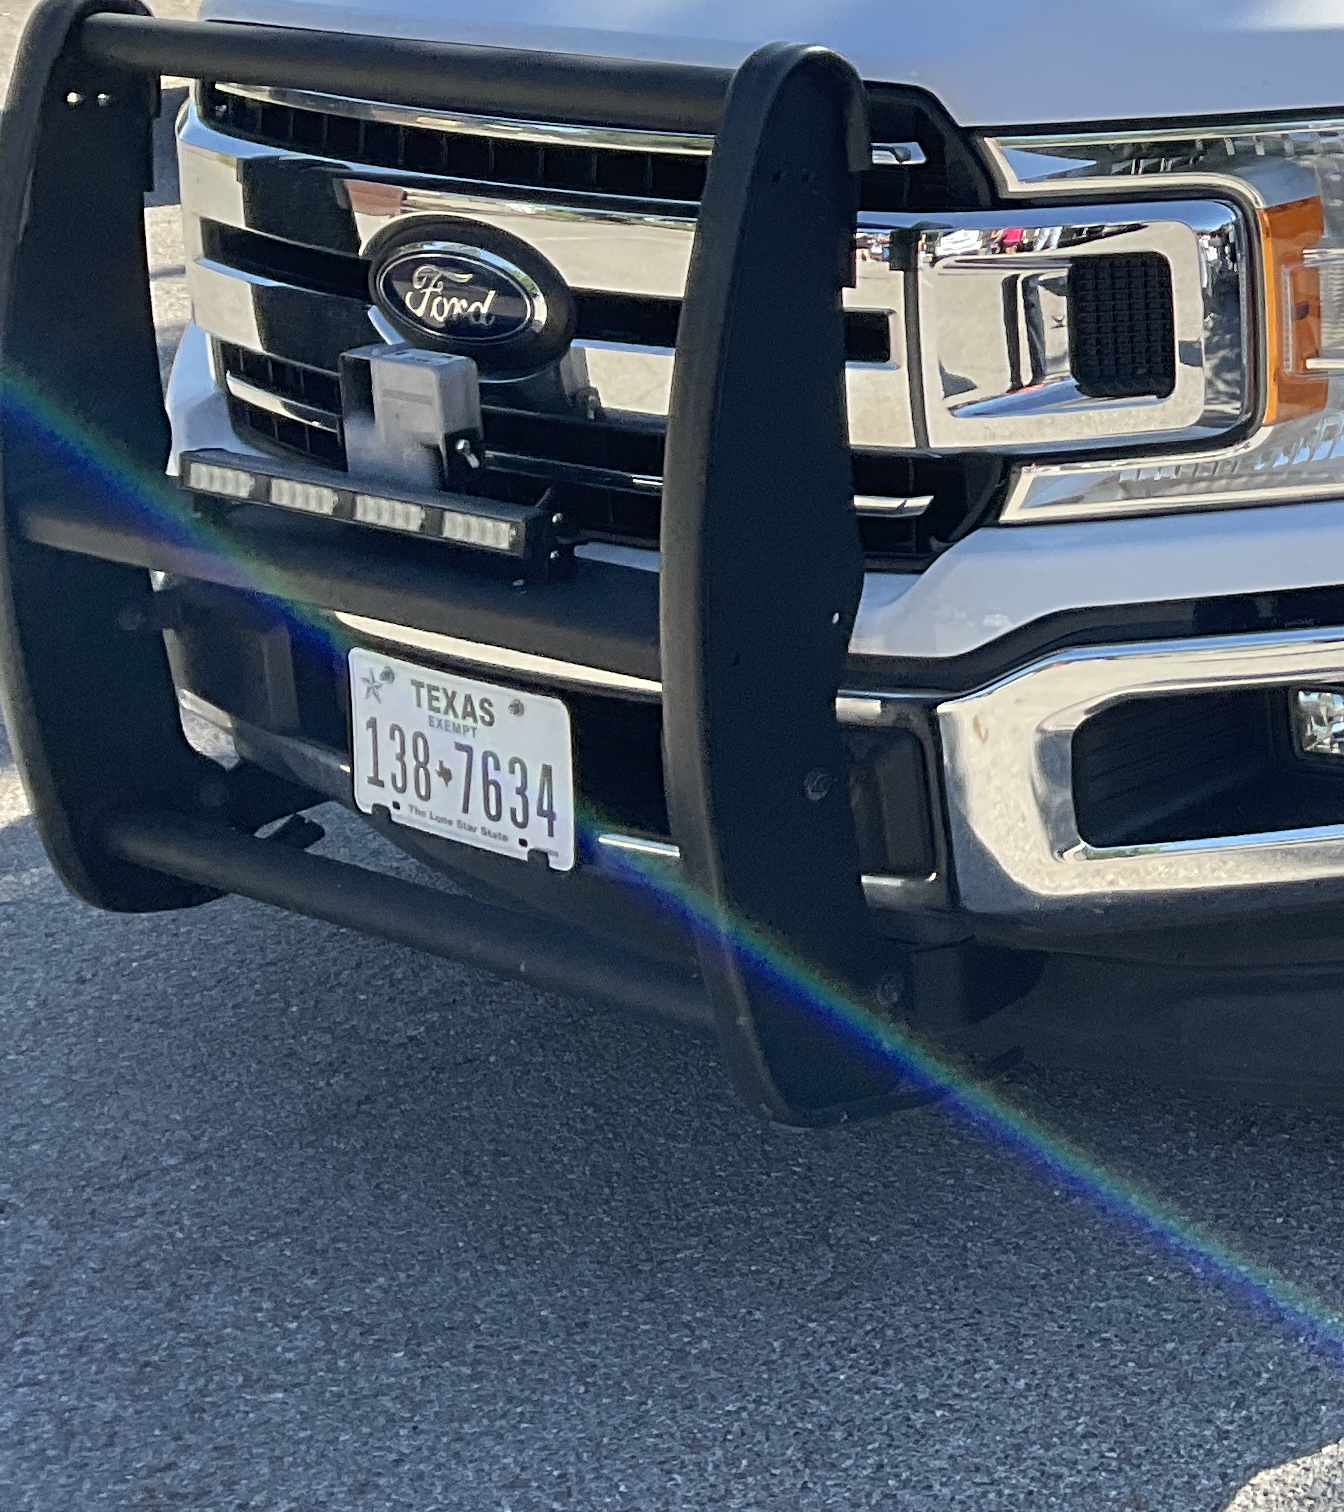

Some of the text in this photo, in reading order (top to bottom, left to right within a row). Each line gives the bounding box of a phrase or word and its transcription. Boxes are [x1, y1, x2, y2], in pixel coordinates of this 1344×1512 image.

[405, 264, 496, 328] Ford
[410, 678, 496, 727] TEXAS
[428, 714, 477, 738] EXEMPT
[408, 804, 509, 842] The Lone Star State
